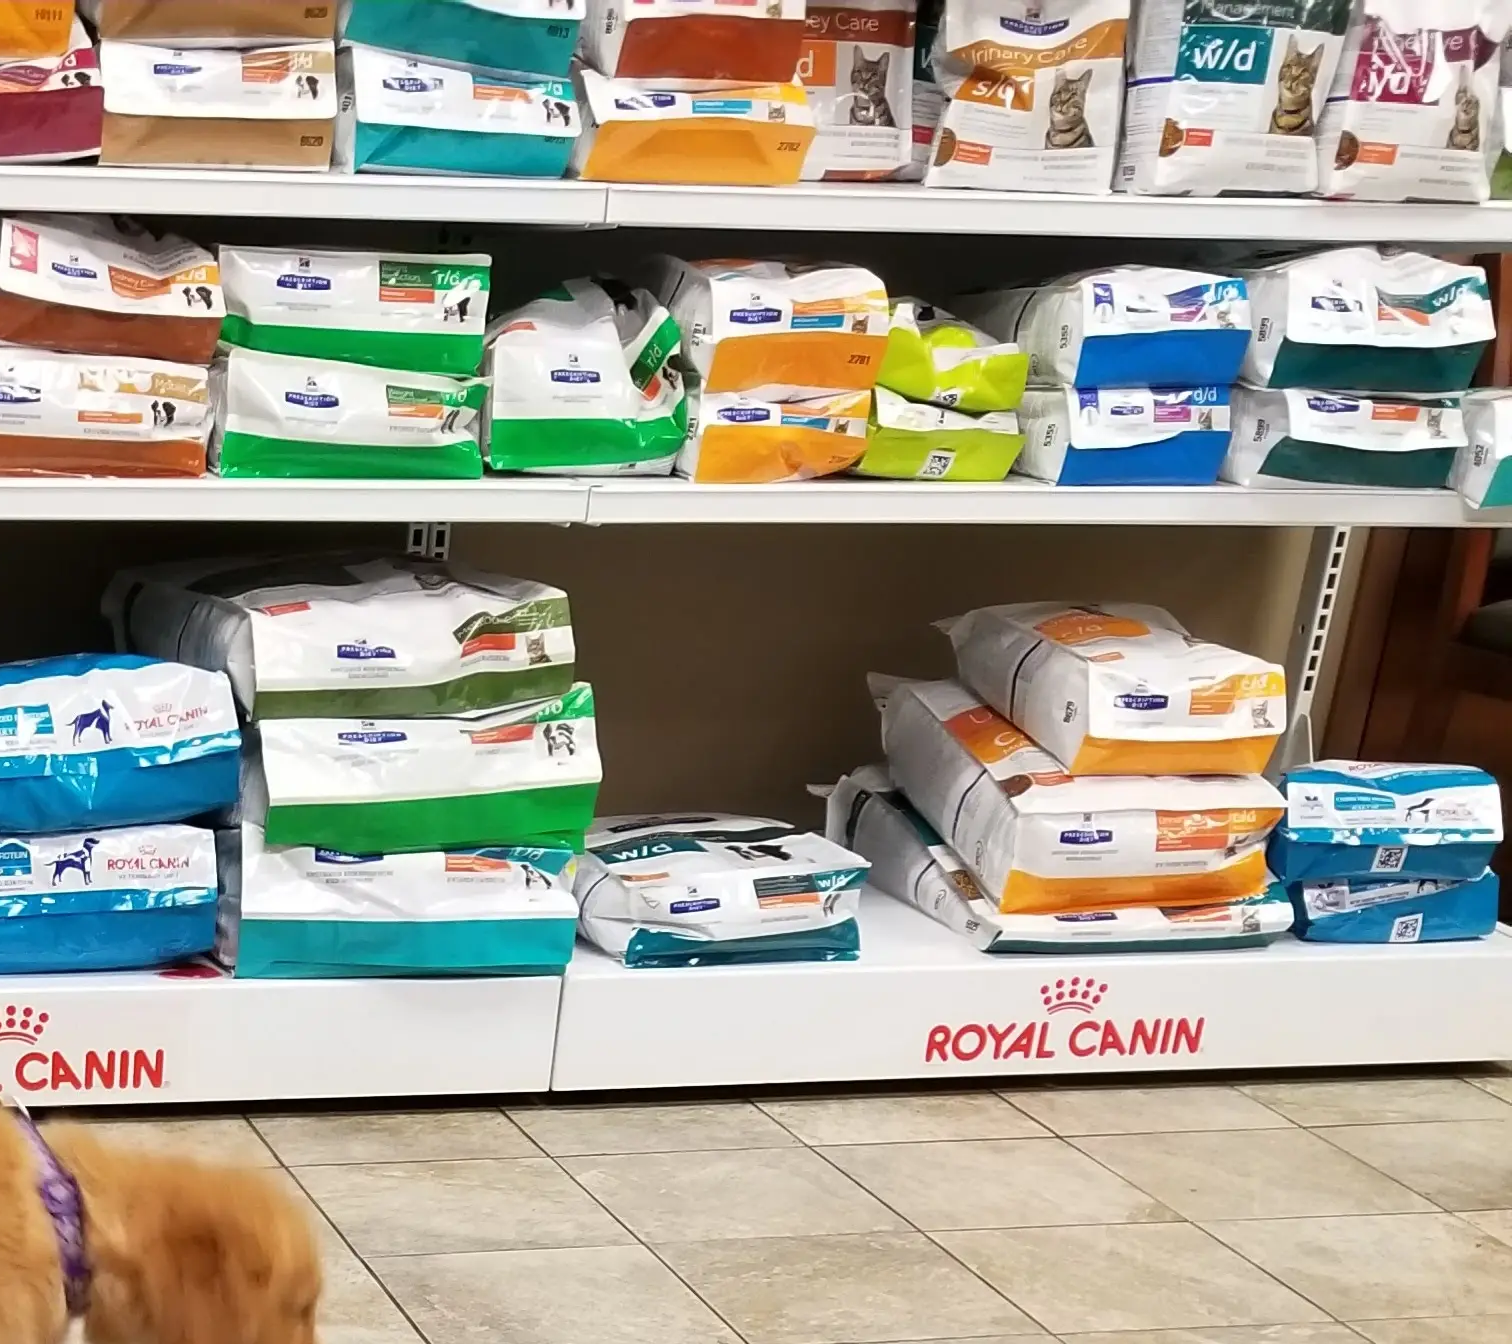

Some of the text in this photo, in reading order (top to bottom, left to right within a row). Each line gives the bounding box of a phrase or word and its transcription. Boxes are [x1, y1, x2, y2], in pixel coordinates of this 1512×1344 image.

[835, 12, 880, 32] Care
[1036, 30, 1089, 63] Care
[1193, 38, 1256, 71] w/d
[646, 344, 664, 368] r/d
[107, 857, 190, 871] ROYAL CANIN
[612, 843, 673, 861] w/d
[925, 1017, 1206, 1063] ROYAL CANIN
[14, 1049, 165, 1091] CANIN
